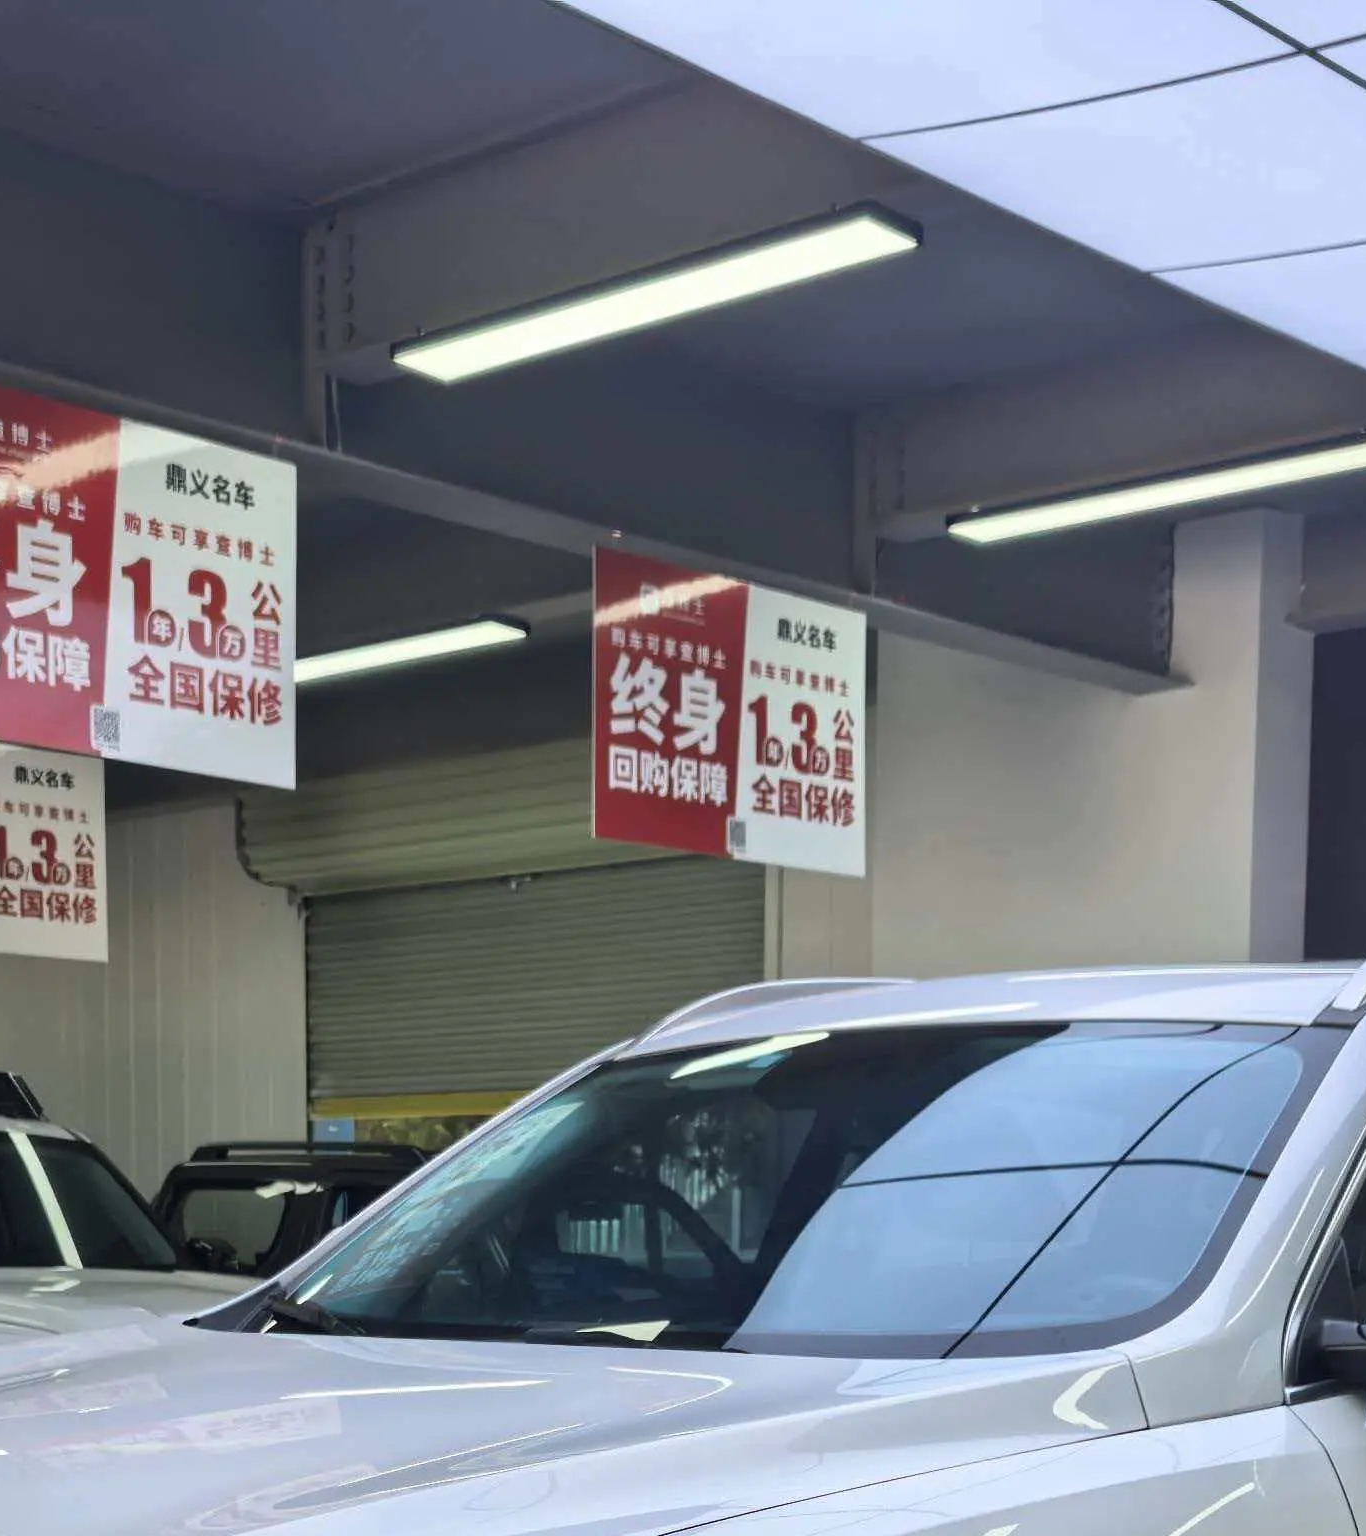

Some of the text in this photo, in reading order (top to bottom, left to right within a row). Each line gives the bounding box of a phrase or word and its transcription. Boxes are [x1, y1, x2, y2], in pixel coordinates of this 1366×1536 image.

[165, 462, 256, 510] 鼎义名车
[123, 511, 276, 567] 购车可享查博士
[127, 653, 283, 727] 全国保修
[609, 652, 727, 756] 终身
[608, 744, 729, 808] 回购保障
[751, 773, 856, 828] 全国保修
